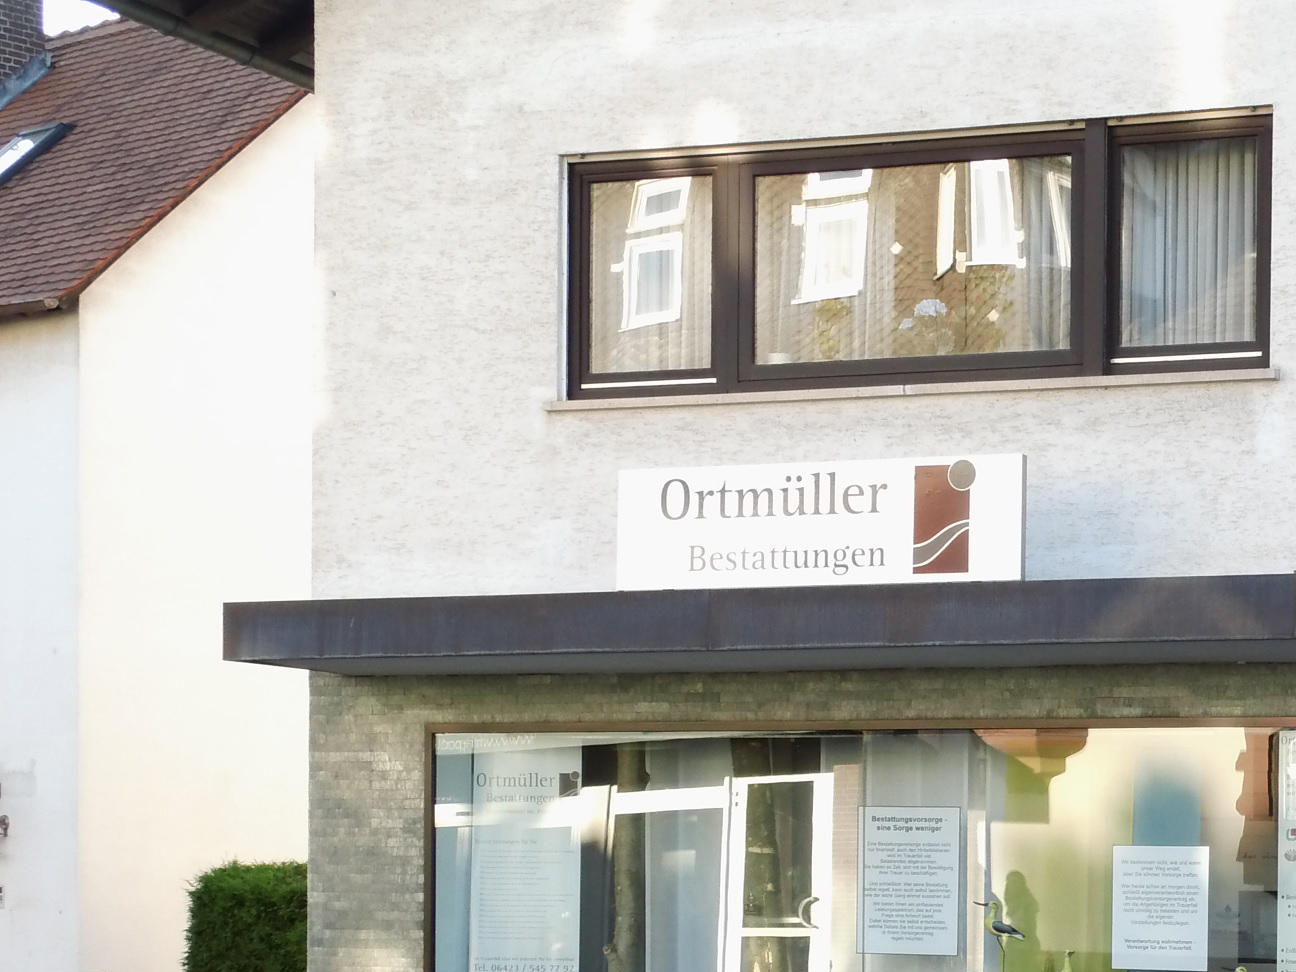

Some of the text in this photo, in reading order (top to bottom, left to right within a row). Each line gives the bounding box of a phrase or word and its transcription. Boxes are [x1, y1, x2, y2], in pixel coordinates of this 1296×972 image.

[660, 471, 888, 521] Ortmüller
[688, 544, 885, 576] Bestattungen
[476, 772, 556, 788] Ortmüller
